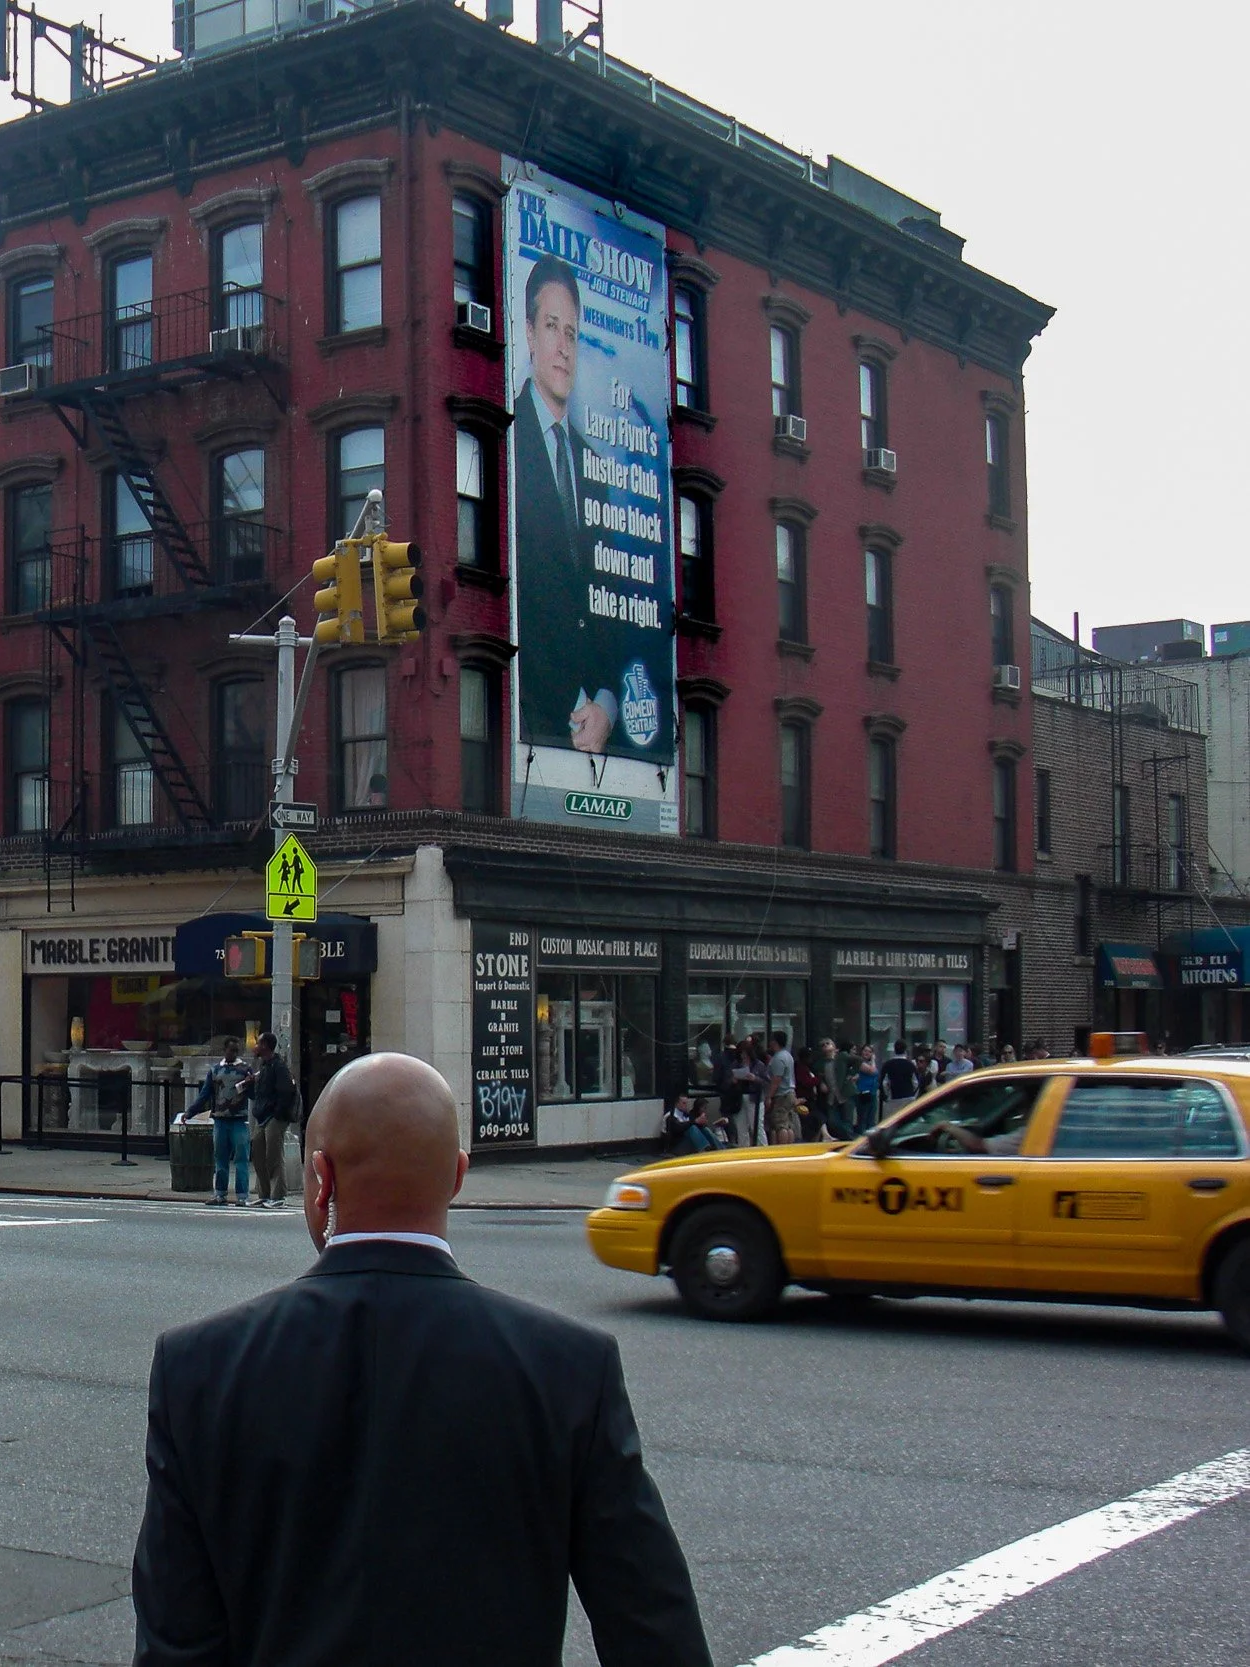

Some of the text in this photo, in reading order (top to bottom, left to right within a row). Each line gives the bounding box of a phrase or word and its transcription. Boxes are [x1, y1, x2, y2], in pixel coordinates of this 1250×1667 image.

[516, 189, 547, 216] THE
[518, 210, 653, 294] DAILY SHOW
[591, 276, 608, 295] JON
[610, 284, 649, 311] STEWART
[583, 305, 634, 340] WEEKNIGHTS
[611, 377, 632, 412] For
[585, 404, 658, 456] Larry Flynt's
[583, 447, 661, 503] Hustler Club,
[584, 497, 662, 543] go one block
[594, 540, 654, 584] down and
[589, 583, 662, 629] take a right.
[624, 699, 656, 720] COMEDY
[628, 717, 657, 734] CENTRAL
[276, 809, 312, 823] ONE WAY
[570, 795, 627, 817] LAMAR
[320, 941, 345, 958] BLE
[509, 932, 529, 947] END
[541, 937, 658, 957] CUSTOM MOSAIC FIRE PLACE
[689, 942, 734, 960] EUROPEAN
[836, 950, 875, 966] MARBLE
[946, 954, 968, 969] TILES
[475, 953, 529, 978] STONE
[475, 980, 497, 993] Import
[504, 980, 530, 991] Domestic
[1181, 968, 1238, 985] KITCHENS
[490, 1000, 518, 1011] MARBLE
[487, 1022, 519, 1032] GRANITE
[482, 1045, 523, 1056] LIME STONE
[476, 1068, 530, 1081] CERAMIC TILES
[479, 1121, 530, 1138] 969-9034
[878, 1177, 965, 1215] TAXI
